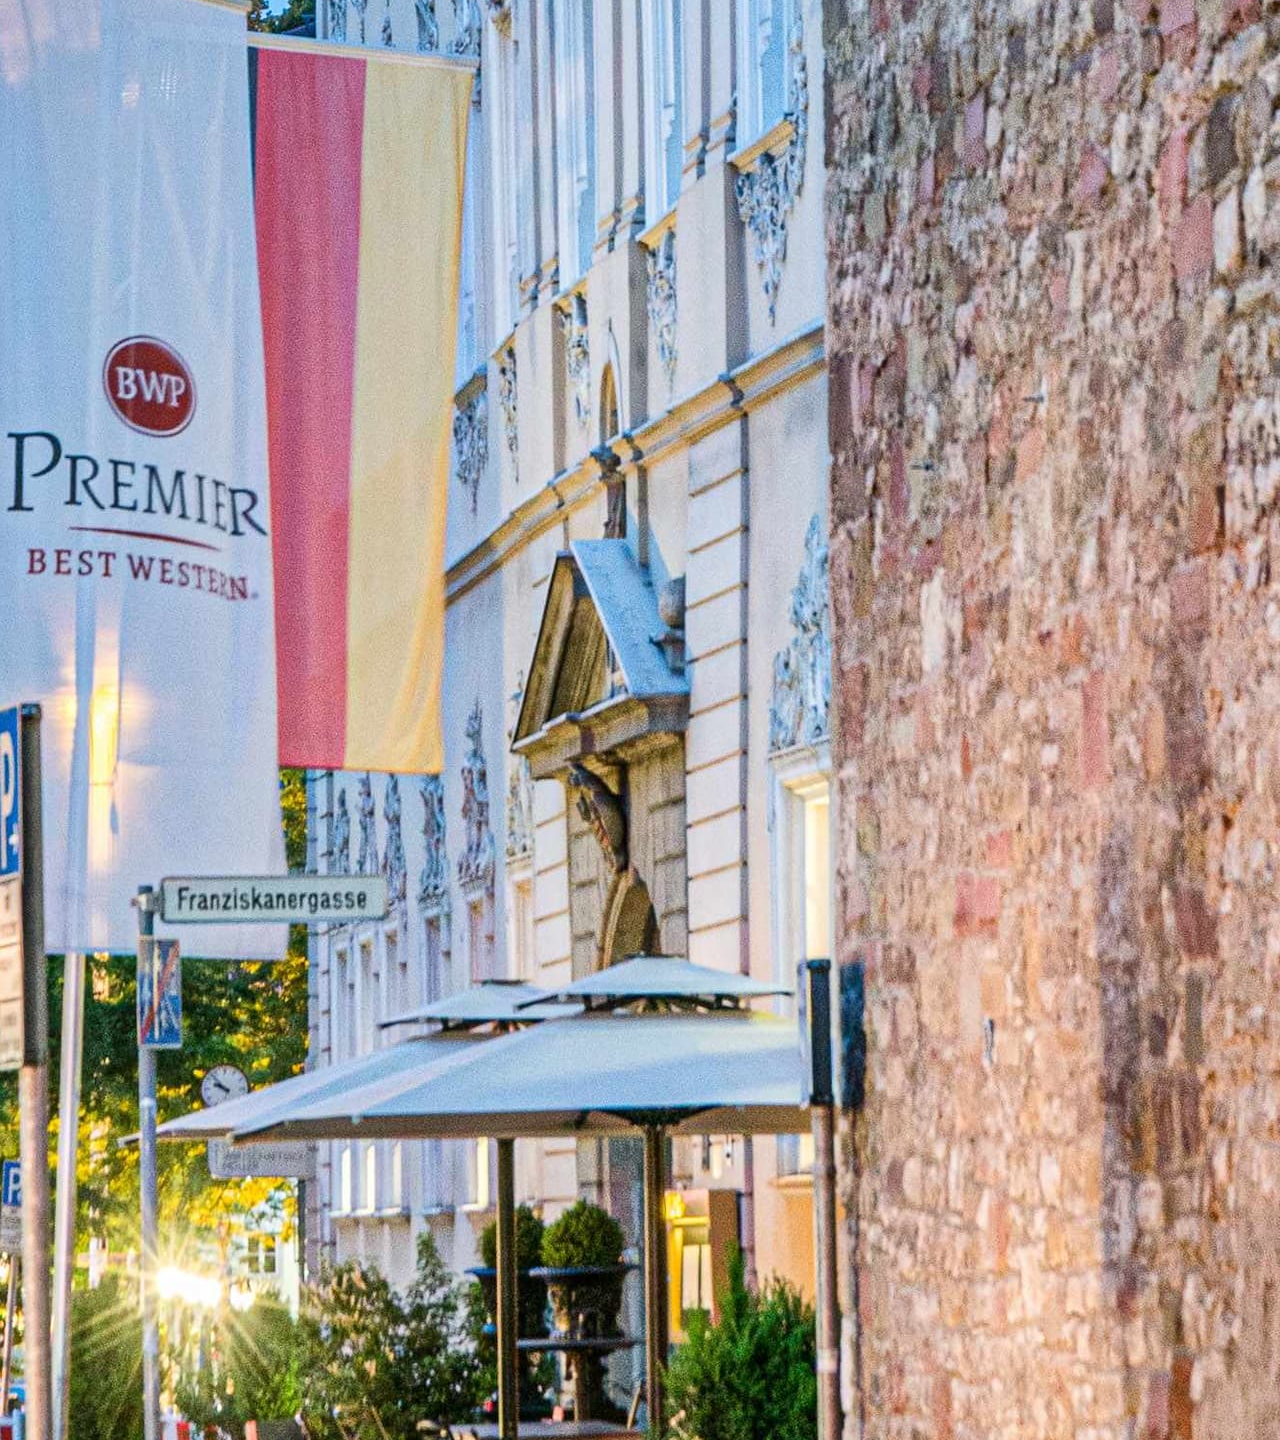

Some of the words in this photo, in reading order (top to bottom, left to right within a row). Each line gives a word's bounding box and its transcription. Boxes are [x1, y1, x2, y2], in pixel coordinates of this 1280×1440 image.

[115, 366, 186, 408] BWP
[7, 431, 268, 537] PREMIER
[27, 549, 117, 578] BEST
[126, 553, 250, 602] WESTERN
[177, 886, 368, 914] Franziskanergasse
